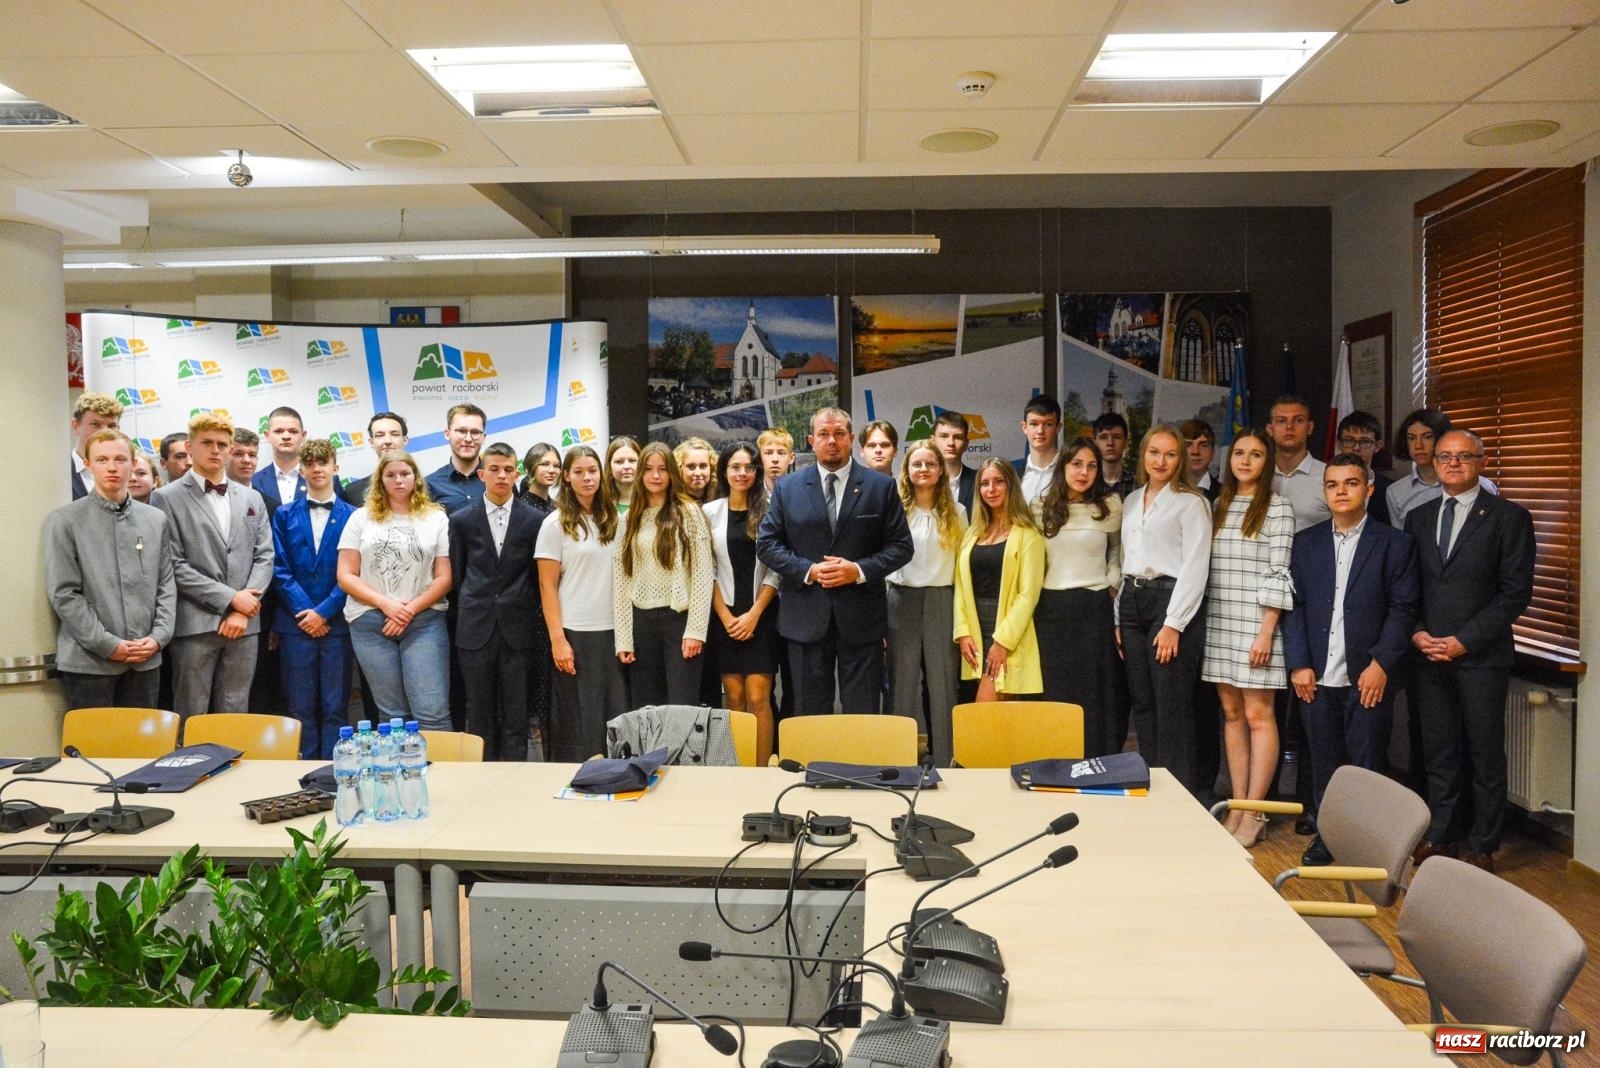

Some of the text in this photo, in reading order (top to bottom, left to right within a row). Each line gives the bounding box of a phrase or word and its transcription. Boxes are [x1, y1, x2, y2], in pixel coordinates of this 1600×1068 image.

[412, 381, 499, 394] powiat raciborski
[965, 443, 992, 453] orski
